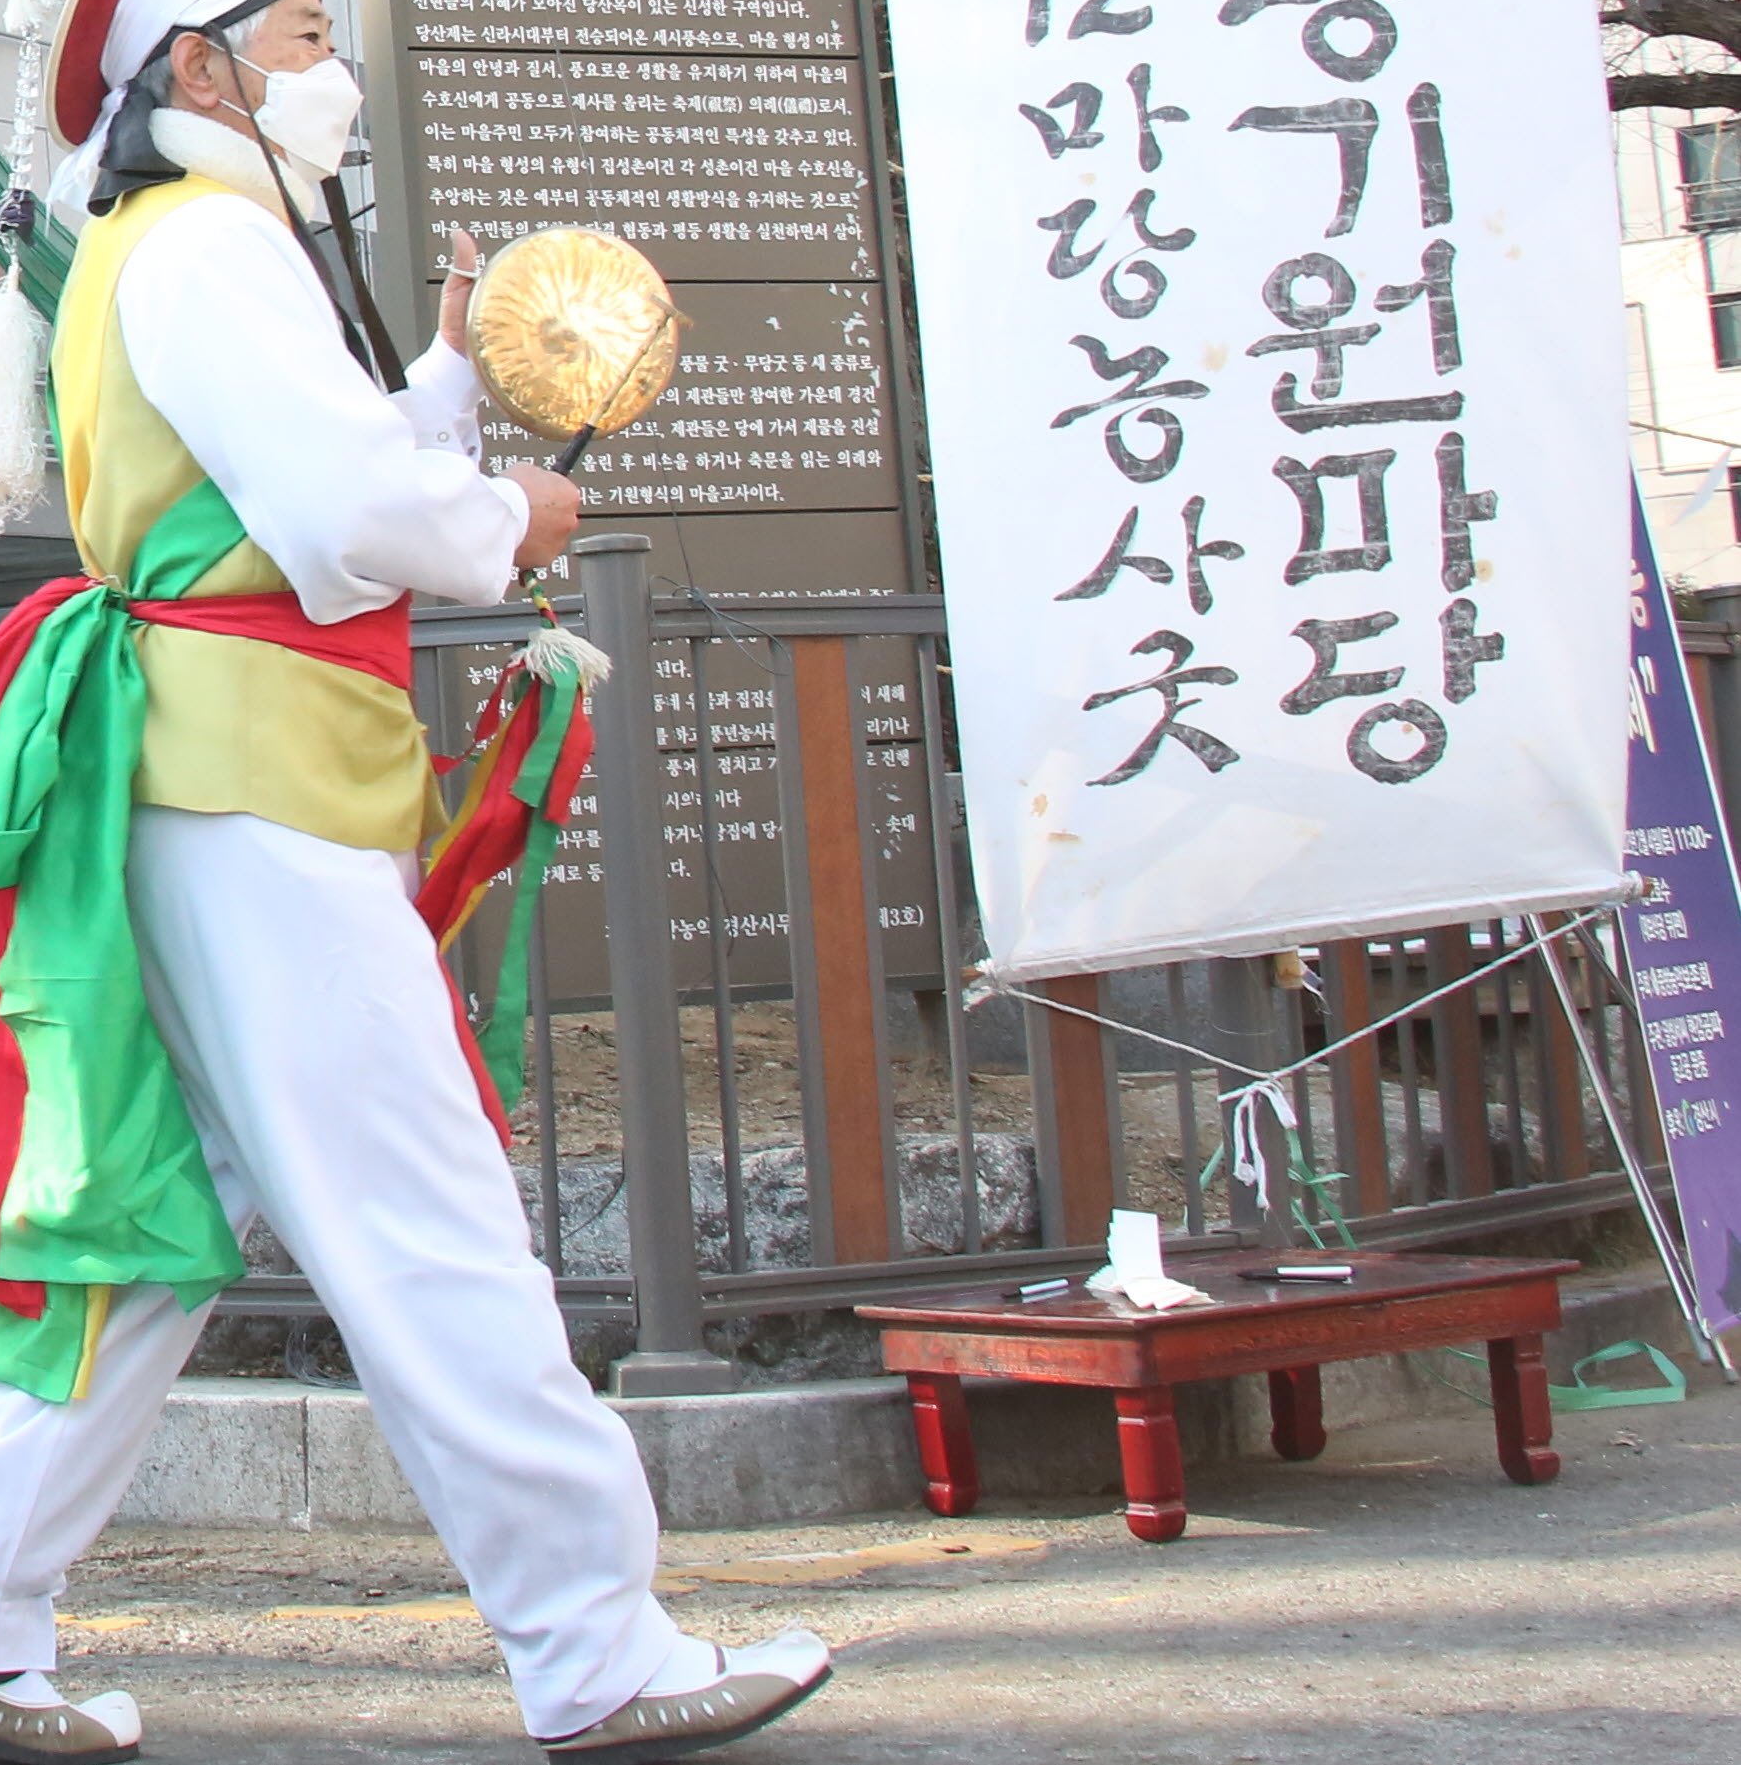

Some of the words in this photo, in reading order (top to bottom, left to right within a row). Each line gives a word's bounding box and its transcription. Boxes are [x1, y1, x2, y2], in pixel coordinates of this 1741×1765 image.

[731, 0, 810, 19] 구역입니다.
[480, 24, 570, 45] 신라시대부터
[574, 26, 649, 47] 전승되어온
[748, 30, 779, 50] 마을
[781, 31, 811, 50] 형성
[815, 32, 844, 51] 이후
[418, 57, 466, 77] 마을의
[472, 58, 521, 78] 안녕과
[568, 60, 631, 80] 풍요로운
[635, 61, 683, 81] 생활을
[686, 63, 747, 83] 유지하기
[753, 64, 798, 84] 위하여
[802, 65, 848, 85] 마을의
[421, 89, 499, 110] 수호신에게
[504, 89, 567, 109] 공동으로
[571, 92, 617, 112] 제사를
[621, 93, 668, 113] 올리는
[424, 121, 457, 141] 이는
[460, 122, 523, 142] 마을주민
[528, 122, 577, 143] 모두가
[579, 124, 641, 144] 참여하는
[645, 125, 721, 145] 공동체적인
[724, 126, 771, 146] 특성을
[773, 127, 819, 146] 갖추고
[426, 154, 458, 174] 특히
[462, 154, 495, 174] 마을
[499, 155, 545, 175] 형성의
[600, 156, 676, 176] 집성촌이건
[679, 157, 696, 176] 각
[700, 157, 759, 177] 성촌이건
[762, 158, 794, 178] 마을
[797, 159, 856, 178] 수호신을
[497, 187, 529, 207] 것은
[584, 188, 661, 209] 공동체적인
[665, 189, 741, 209] 생활방식을
[745, 190, 805, 209] 유지하는
[469, 221, 529, 240] 주민들의
[671, 221, 703, 241] 평등
[706, 221, 752, 241] 생활을
[755, 221, 829, 241] 실천하면서
[679, 354, 710, 374] 풍물
[743, 353, 789, 373] 무당굿
[791, 354, 808, 373] 등
[810, 353, 827, 372] 새
[685, 386, 746, 406] 제관들만
[749, 385, 795, 405] 참여한
[798, 385, 843, 405] 가운데
[847, 385, 877, 404] 경건
[670, 419, 731, 438] 제관들은
[733, 418, 764, 438] 당에
[768, 417, 798, 437] 가서
[802, 417, 847, 436] 제물을
[851, 417, 881, 436] 진설
[581, 453, 614, 473] 올린
[619, 452, 636, 472] 후
[694, 451, 743, 471] 하거나
[747, 450, 795, 470] 축문을
[800, 449, 831, 469] 읽는
[836, 448, 883, 468] 의례와
[608, 484, 684, 505] 기원형식의
[688, 482, 785, 503] 마을고사이다.
[877, 683, 906, 704] 새해
[881, 748, 911, 768] 진행
